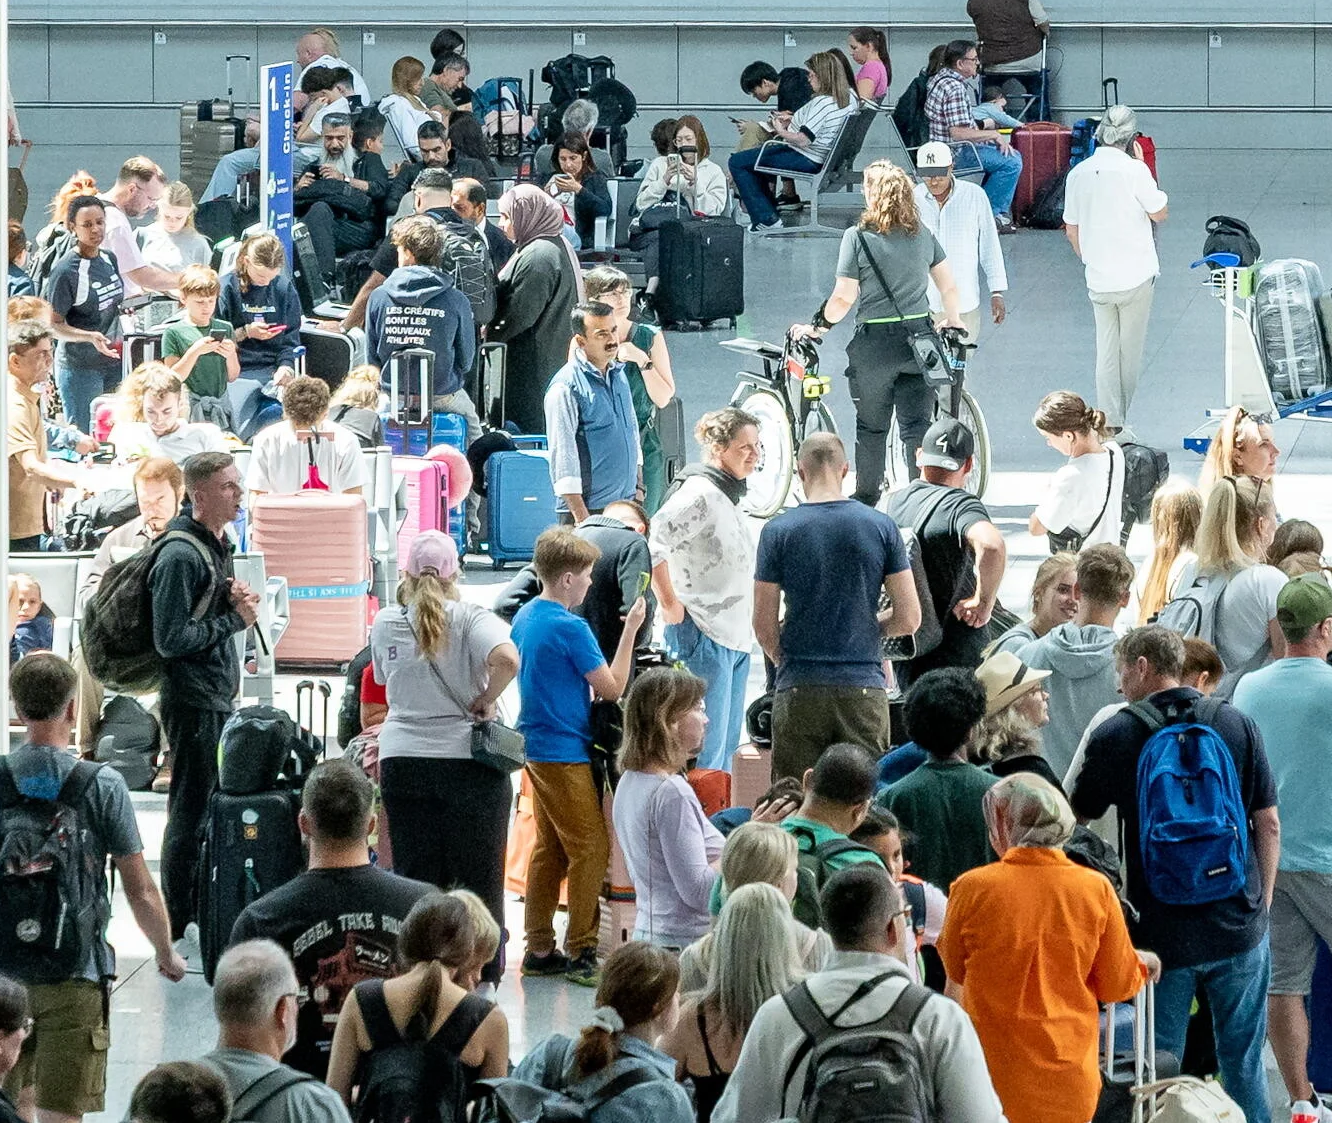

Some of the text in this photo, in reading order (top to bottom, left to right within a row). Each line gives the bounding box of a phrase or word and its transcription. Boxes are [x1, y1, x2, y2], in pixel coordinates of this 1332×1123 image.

[269, 76, 280, 111] 1.
[283, 73, 291, 154] Check-in
[385, 317, 427, 326] SONT LES
[386, 305, 446, 318] LES CRÉATIFS
[385, 327, 432, 337] NOUVEAUX
[936, 433, 949, 453] 4
[337, 912, 376, 932] TAKE
